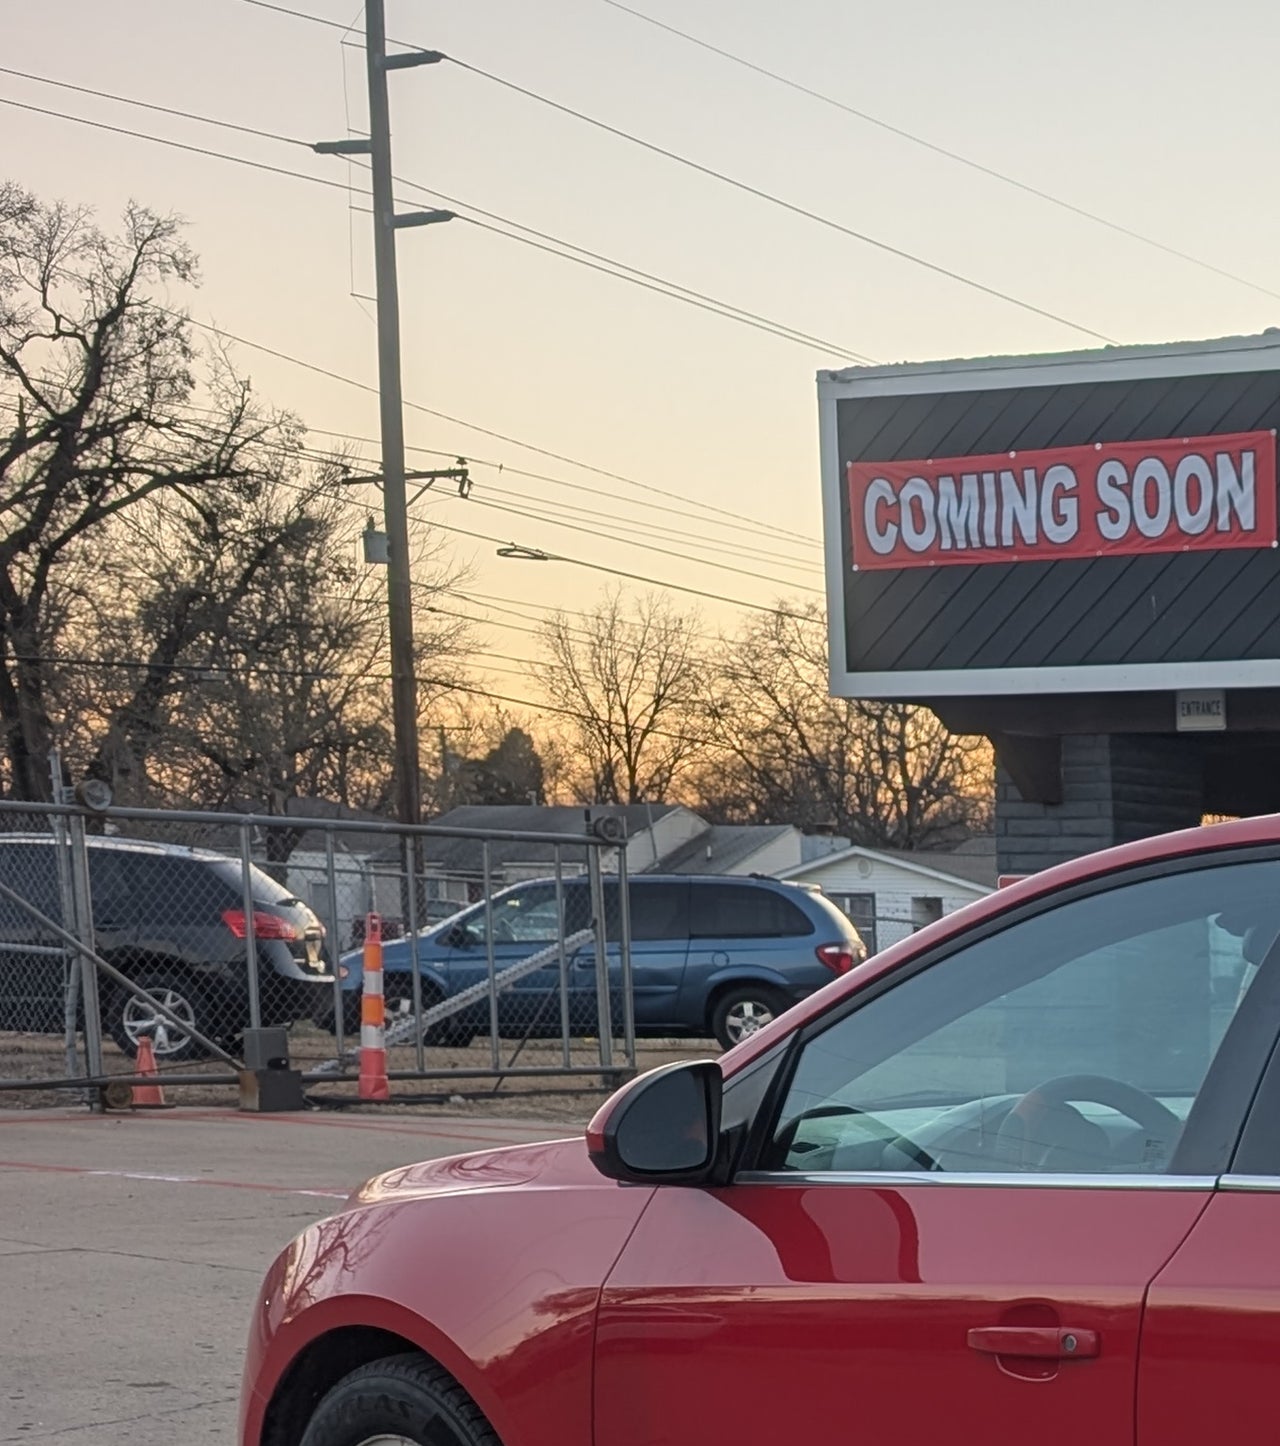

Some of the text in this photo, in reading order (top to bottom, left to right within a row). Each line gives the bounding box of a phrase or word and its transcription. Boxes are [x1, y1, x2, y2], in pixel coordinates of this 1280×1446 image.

[863, 449, 1256, 555] COMING SOON
[1181, 700, 1222, 717] ENTRANCE
